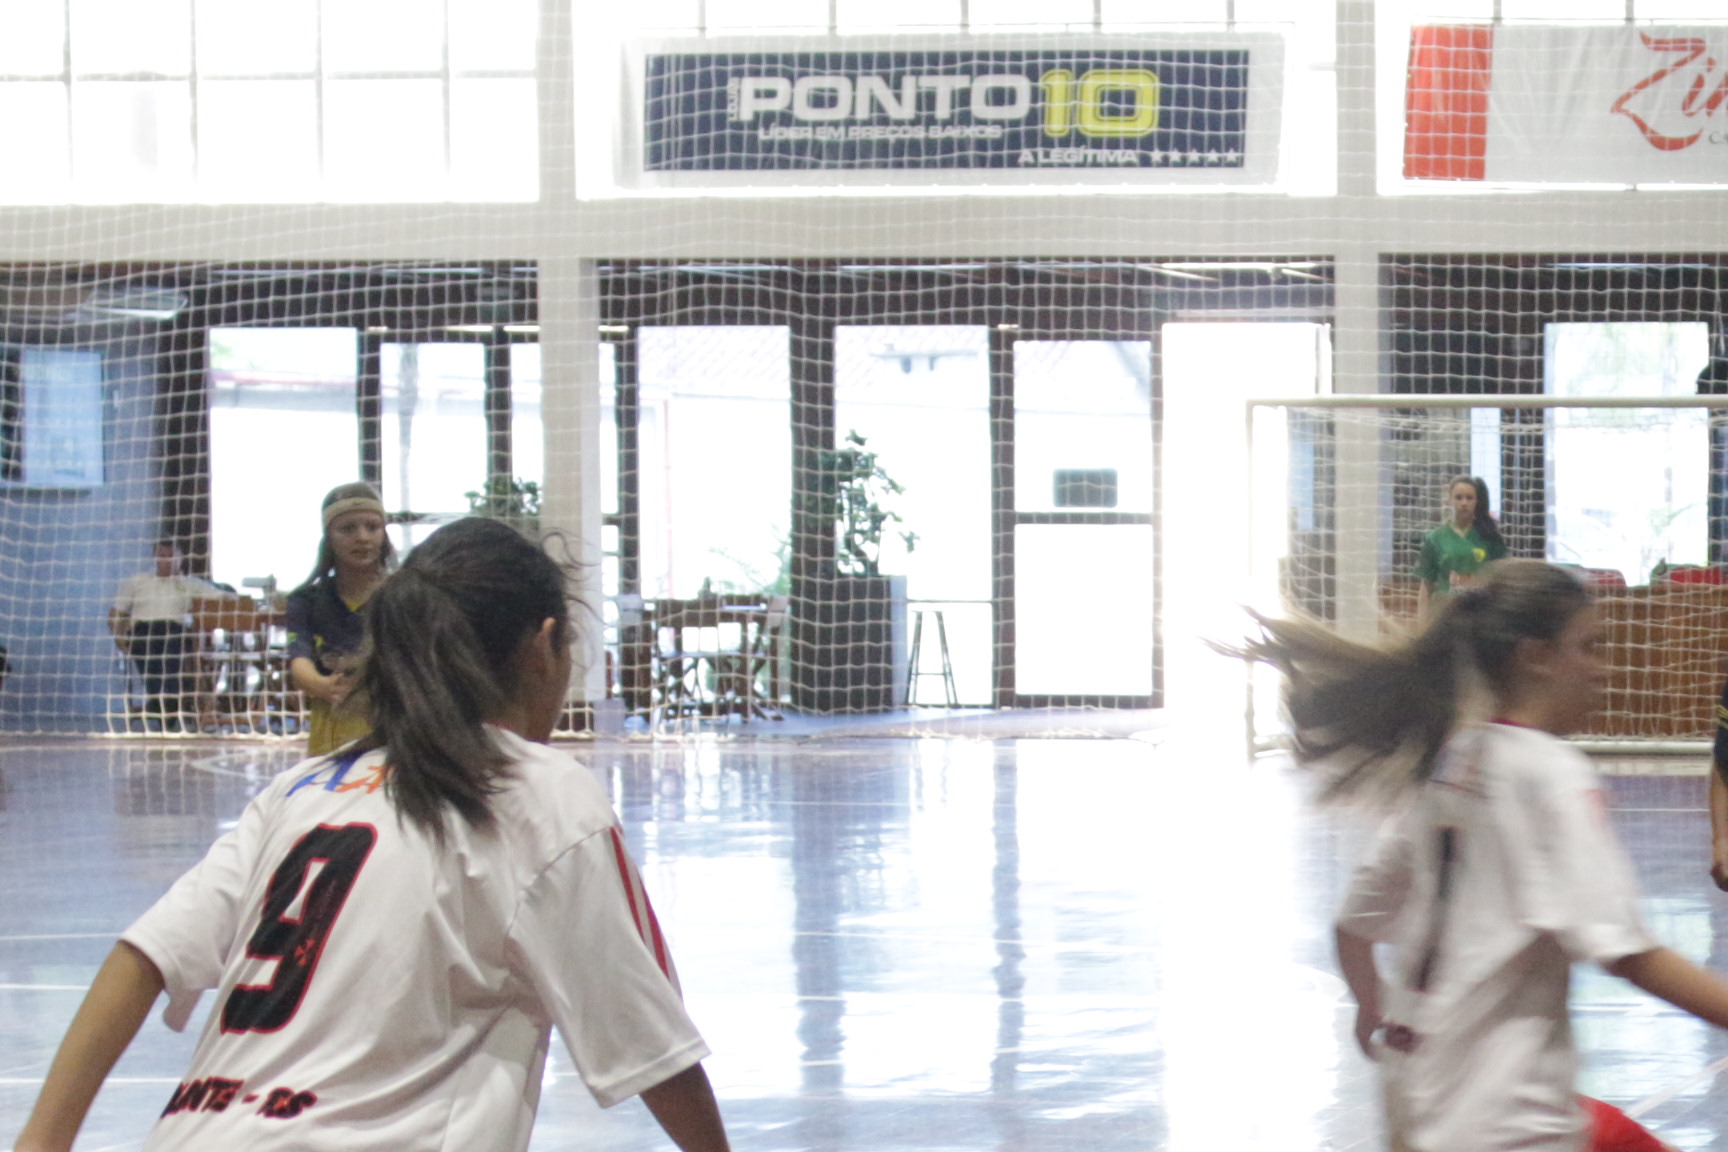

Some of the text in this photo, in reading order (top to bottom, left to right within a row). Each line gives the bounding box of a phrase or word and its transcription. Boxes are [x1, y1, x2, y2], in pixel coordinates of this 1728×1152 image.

[758, 122, 1002, 143] LÍDER EM PREÇOS BAIXOS
[1018, 146, 1139, 163] A LEGÍTIMA
[219, 822, 379, 1034] 9
